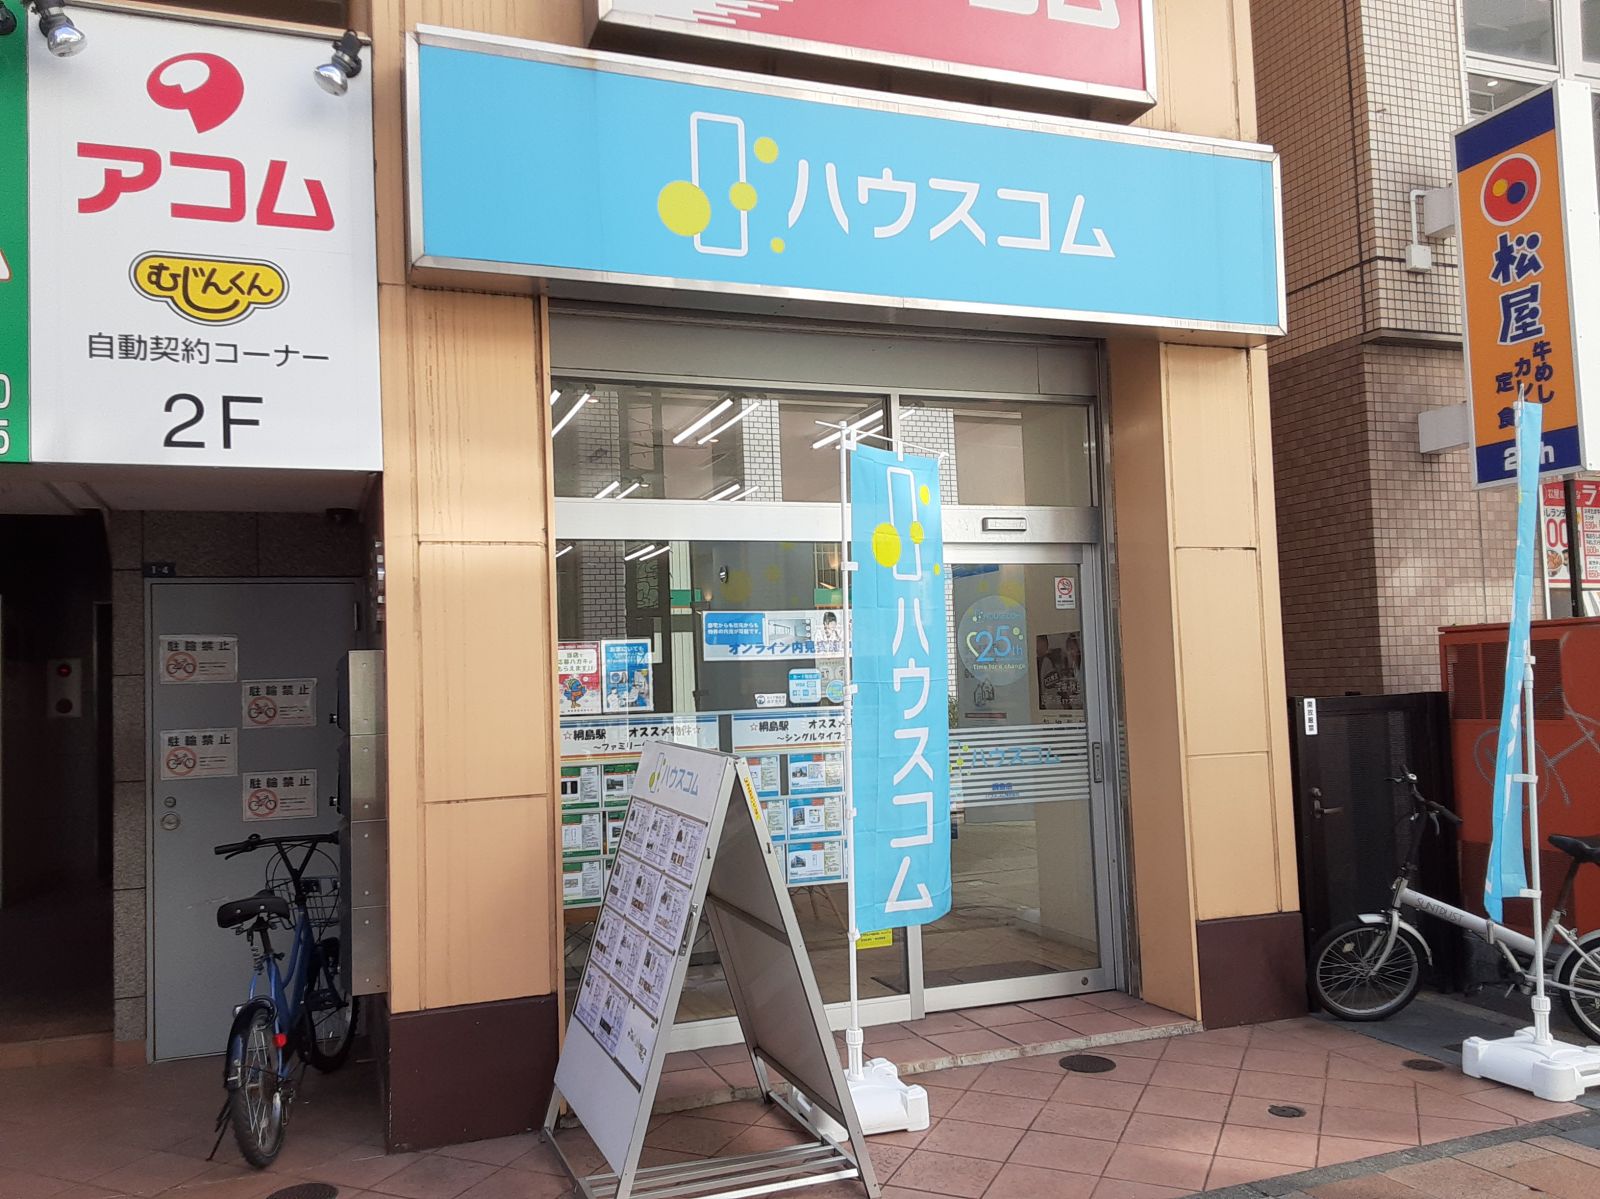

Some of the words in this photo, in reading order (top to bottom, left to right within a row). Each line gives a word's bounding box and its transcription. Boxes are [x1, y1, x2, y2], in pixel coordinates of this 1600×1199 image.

[77, 141, 335, 231] アコム
[787, 159, 1116, 258] ハウスコム
[145, 261, 276, 298] むじんくん
[1489, 230, 1544, 346] 松屋
[87, 331, 330, 368] 自動契約コーナー
[1514, 357, 1534, 402] カレ
[1532, 340, 1555, 404] 牛めし
[162, 393, 264, 449] 2F
[167, 640, 231, 652] 駐輪禁止
[249, 684, 310, 697] 駐輪禁止
[167, 734, 231, 747] 駐輪禁止
[884, 596, 935, 914] ハウスコム
[970, 745, 1060, 768] ハウスコム
[249, 776, 311, 789] 駐輪禁止
[661, 764, 699, 796] ハウスコム
